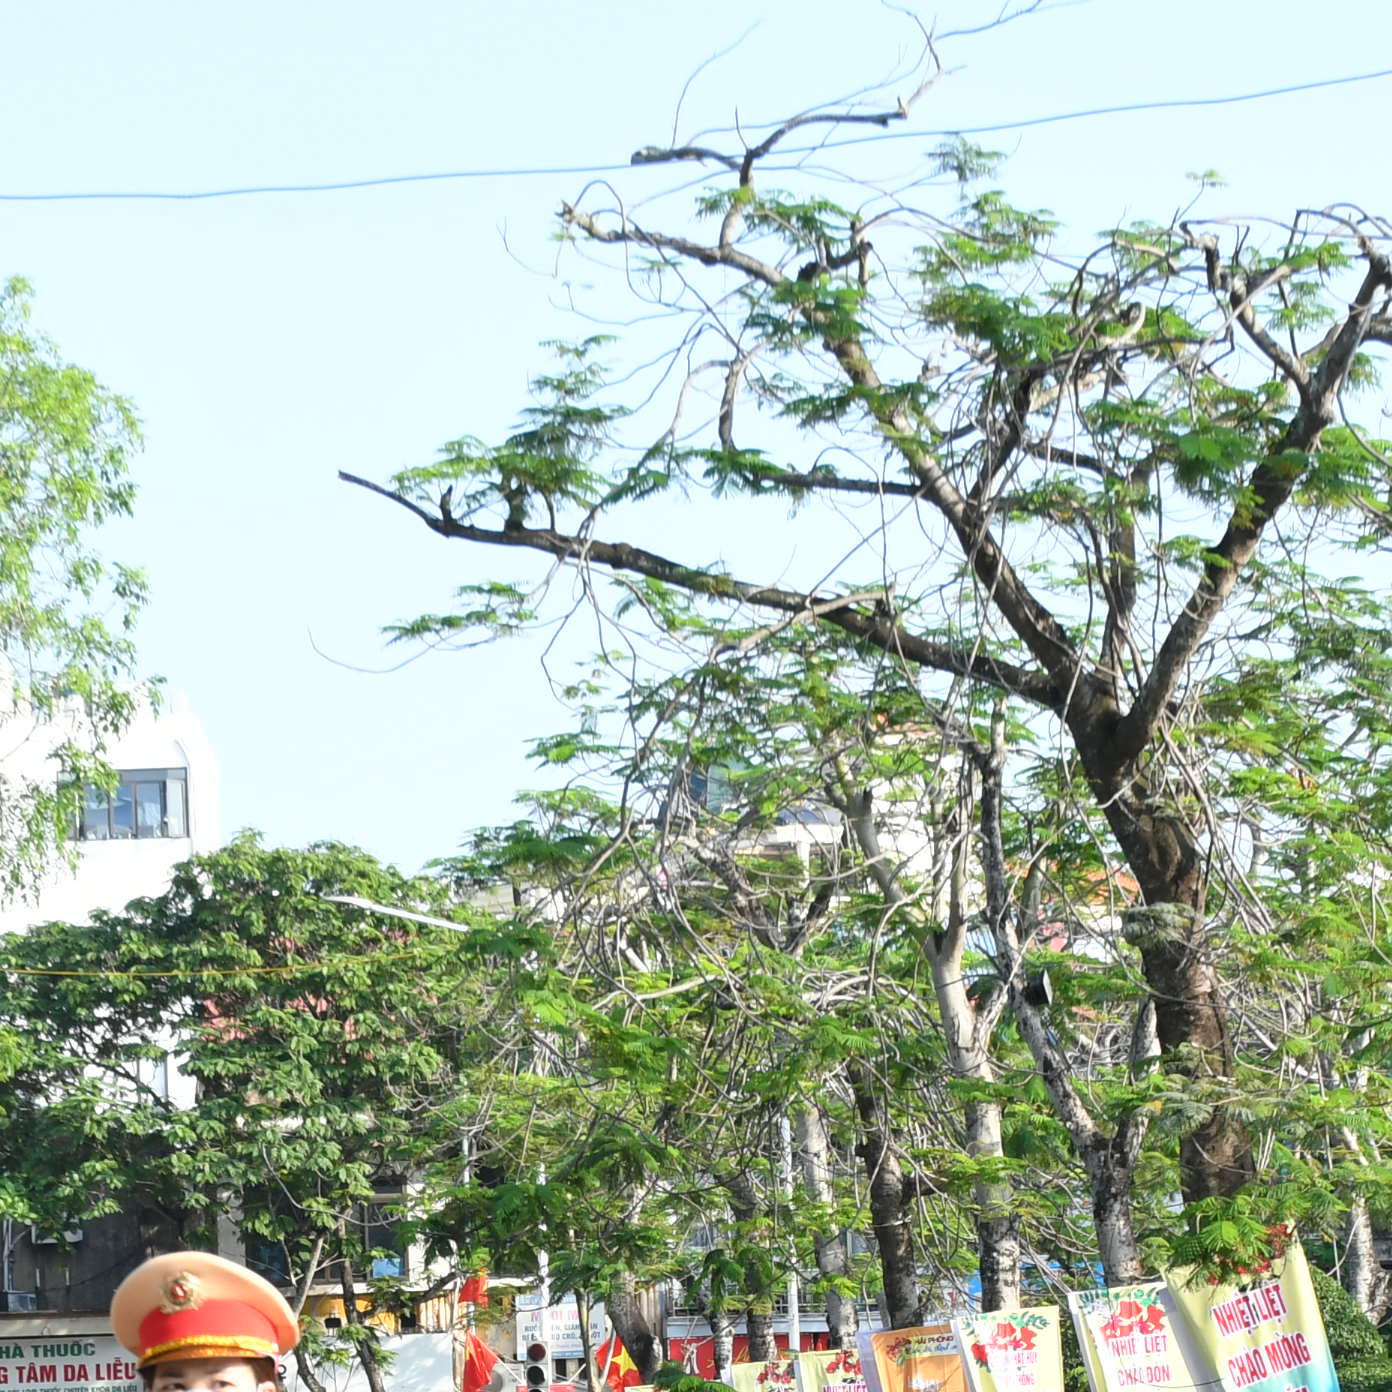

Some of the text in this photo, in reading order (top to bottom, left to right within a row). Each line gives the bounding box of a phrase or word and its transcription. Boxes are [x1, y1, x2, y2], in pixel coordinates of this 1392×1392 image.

[31, 1338, 96, 1358] THUỐC
[1265, 1331, 1312, 1374] MỪNG
[16, 1362, 58, 1384] TÂM
[63, 1363, 89, 1382] DA
[95, 1357, 137, 1381] LIỄU
